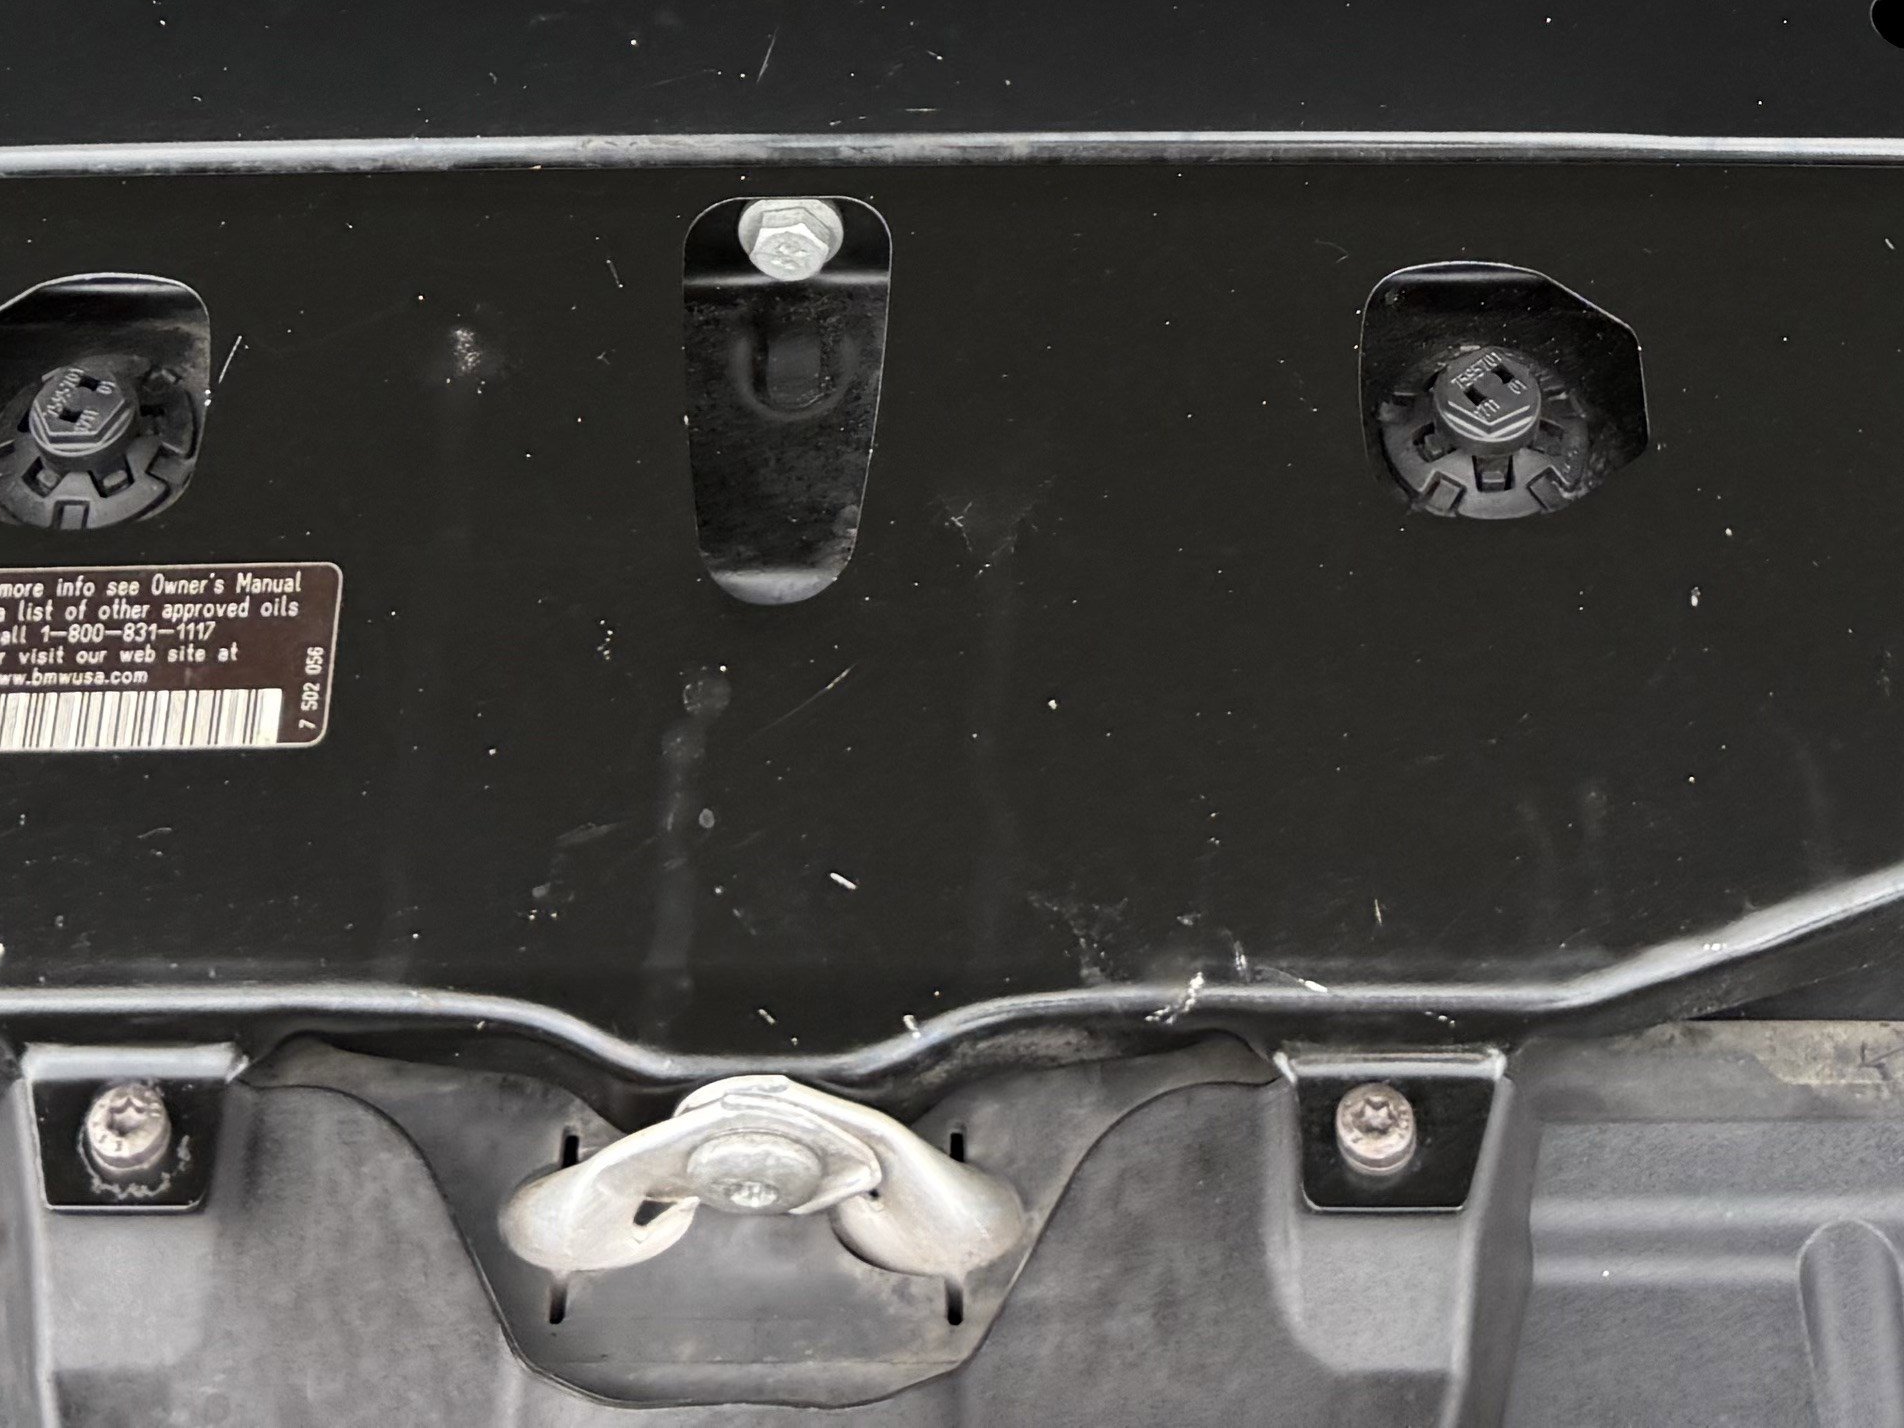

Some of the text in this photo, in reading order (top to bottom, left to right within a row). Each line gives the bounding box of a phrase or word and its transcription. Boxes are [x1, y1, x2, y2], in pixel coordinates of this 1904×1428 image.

[56, 574, 96, 598] info
[105, 580, 140, 597] see
[150, 572, 225, 597] Owner's
[235, 570, 302, 594] Manual
[17, 598, 54, 622] list
[64, 598, 88, 622] of
[97, 597, 151, 621] other
[162, 594, 251, 619] approved
[259, 595, 299, 618] oils
[18, 645, 65, 666] visit
[75, 650, 108, 665] our
[119, 643, 156, 664] web
[167, 642, 206, 663] site
[217, 641, 239, 663] at
[298, 646, 325, 730] 7 502 056
